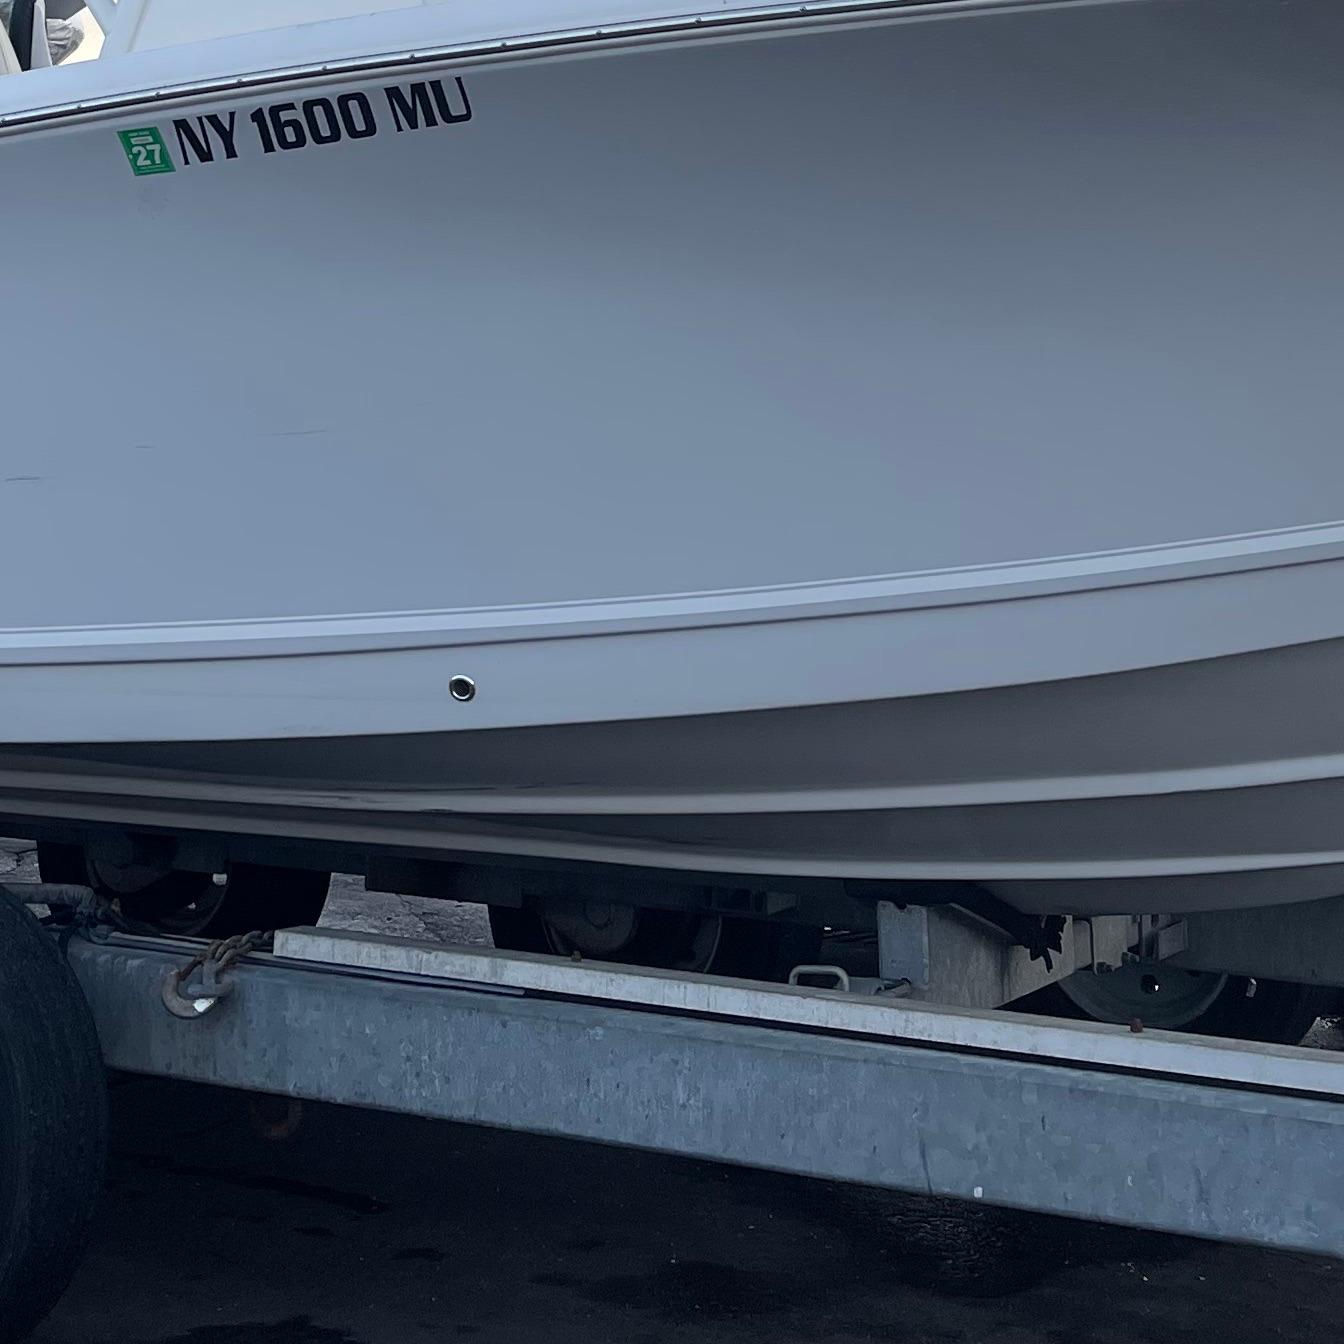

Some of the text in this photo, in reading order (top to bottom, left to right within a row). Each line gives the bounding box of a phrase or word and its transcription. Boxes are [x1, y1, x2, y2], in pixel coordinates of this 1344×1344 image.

[172, 77, 472, 165] NY 1600 MU
[131, 144, 161, 166] 27
